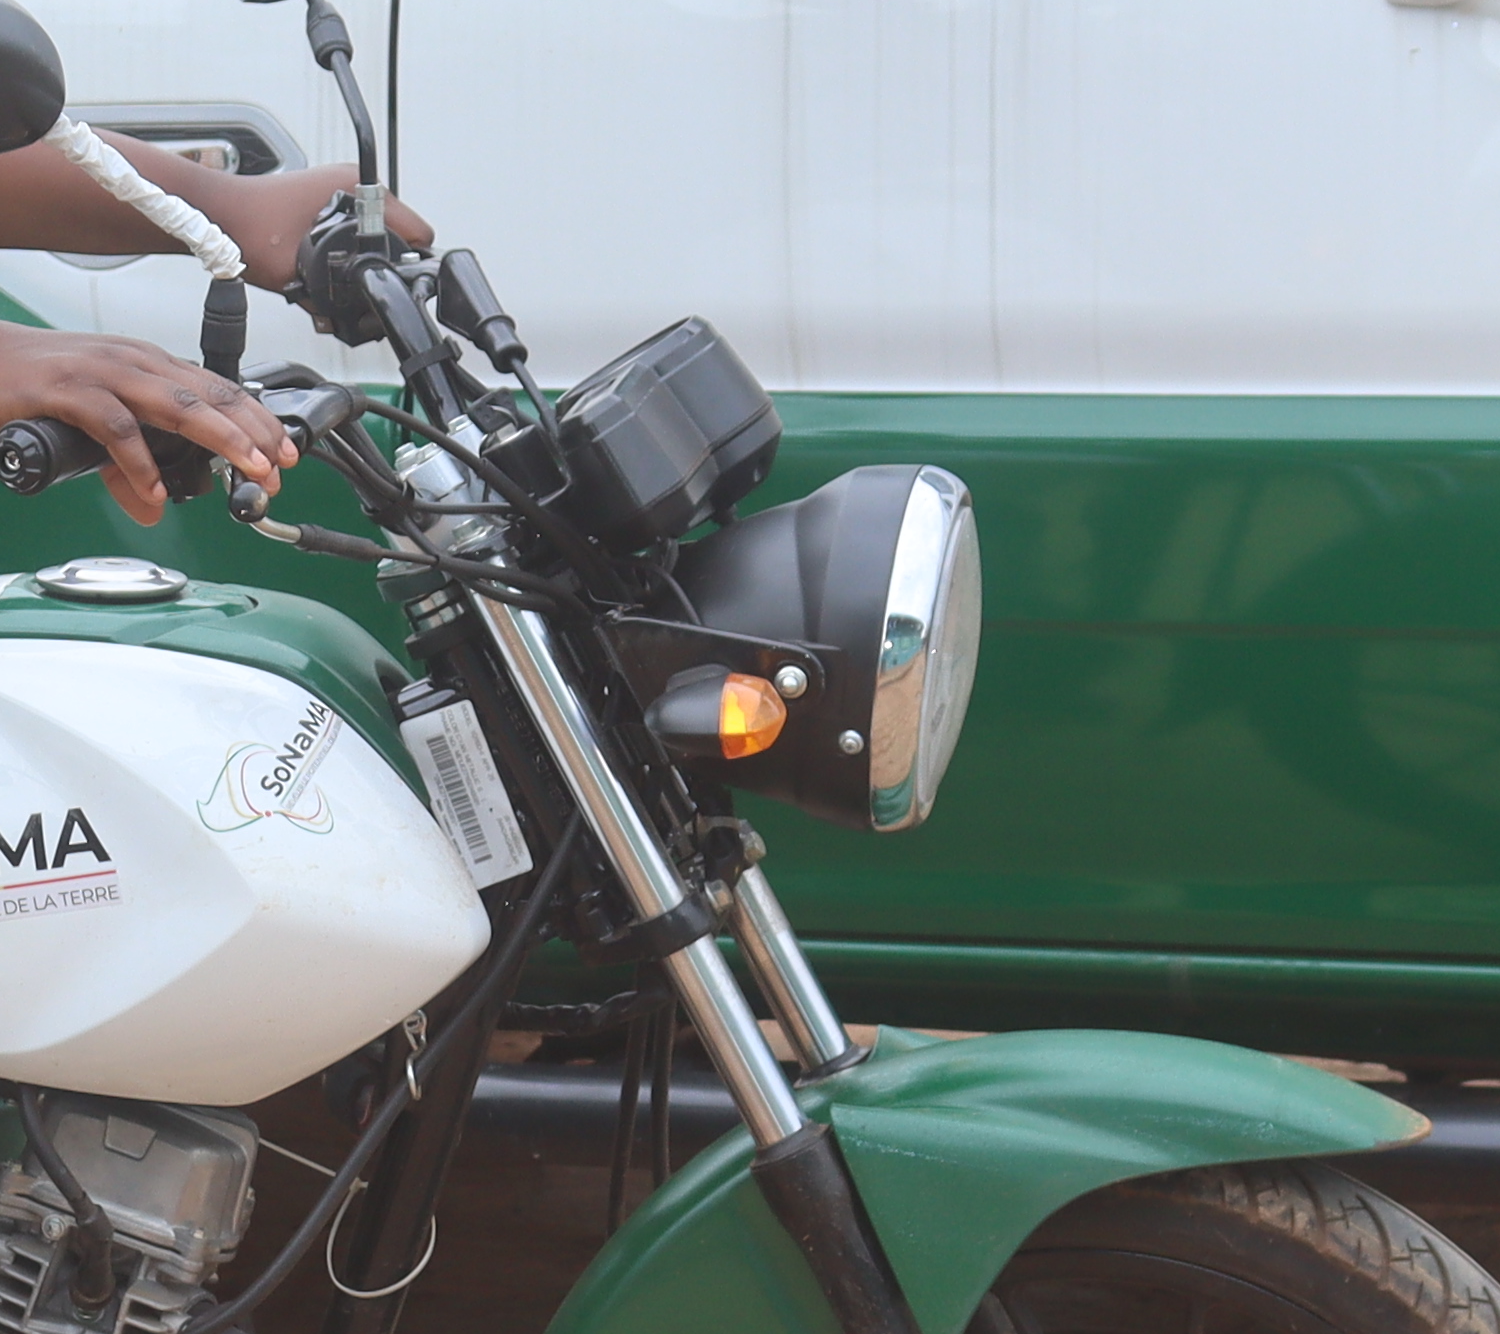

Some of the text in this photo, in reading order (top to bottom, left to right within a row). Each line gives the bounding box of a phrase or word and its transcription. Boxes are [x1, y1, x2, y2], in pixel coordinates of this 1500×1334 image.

[261, 701, 330, 798] SoNaMA
[3, 897, 30, 916] DE
[33, 894, 58, 911] LA
[58, 884, 120, 908] TERRE
